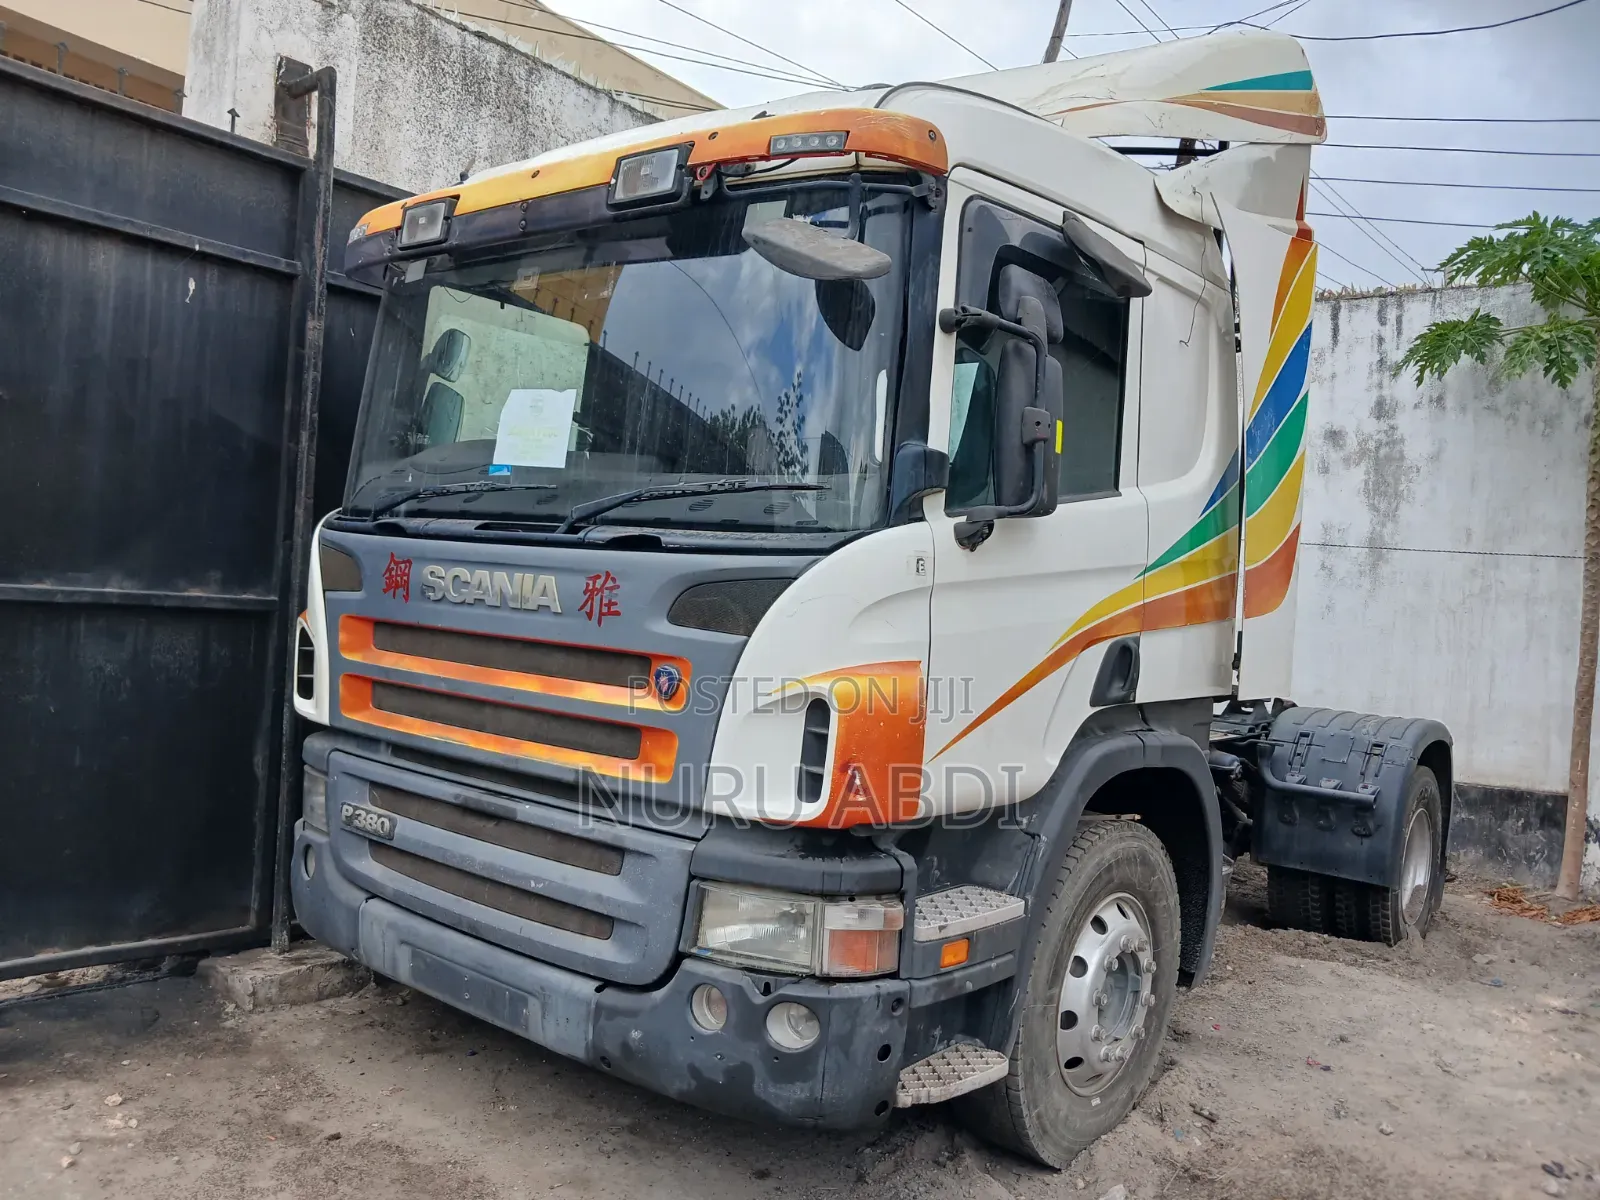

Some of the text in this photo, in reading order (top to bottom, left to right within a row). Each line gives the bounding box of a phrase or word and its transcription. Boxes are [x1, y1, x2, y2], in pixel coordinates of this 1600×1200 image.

[382, 552, 413, 604] 鋼
[420, 564, 561, 614] SCANIA
[577, 570, 622, 628] 雅
